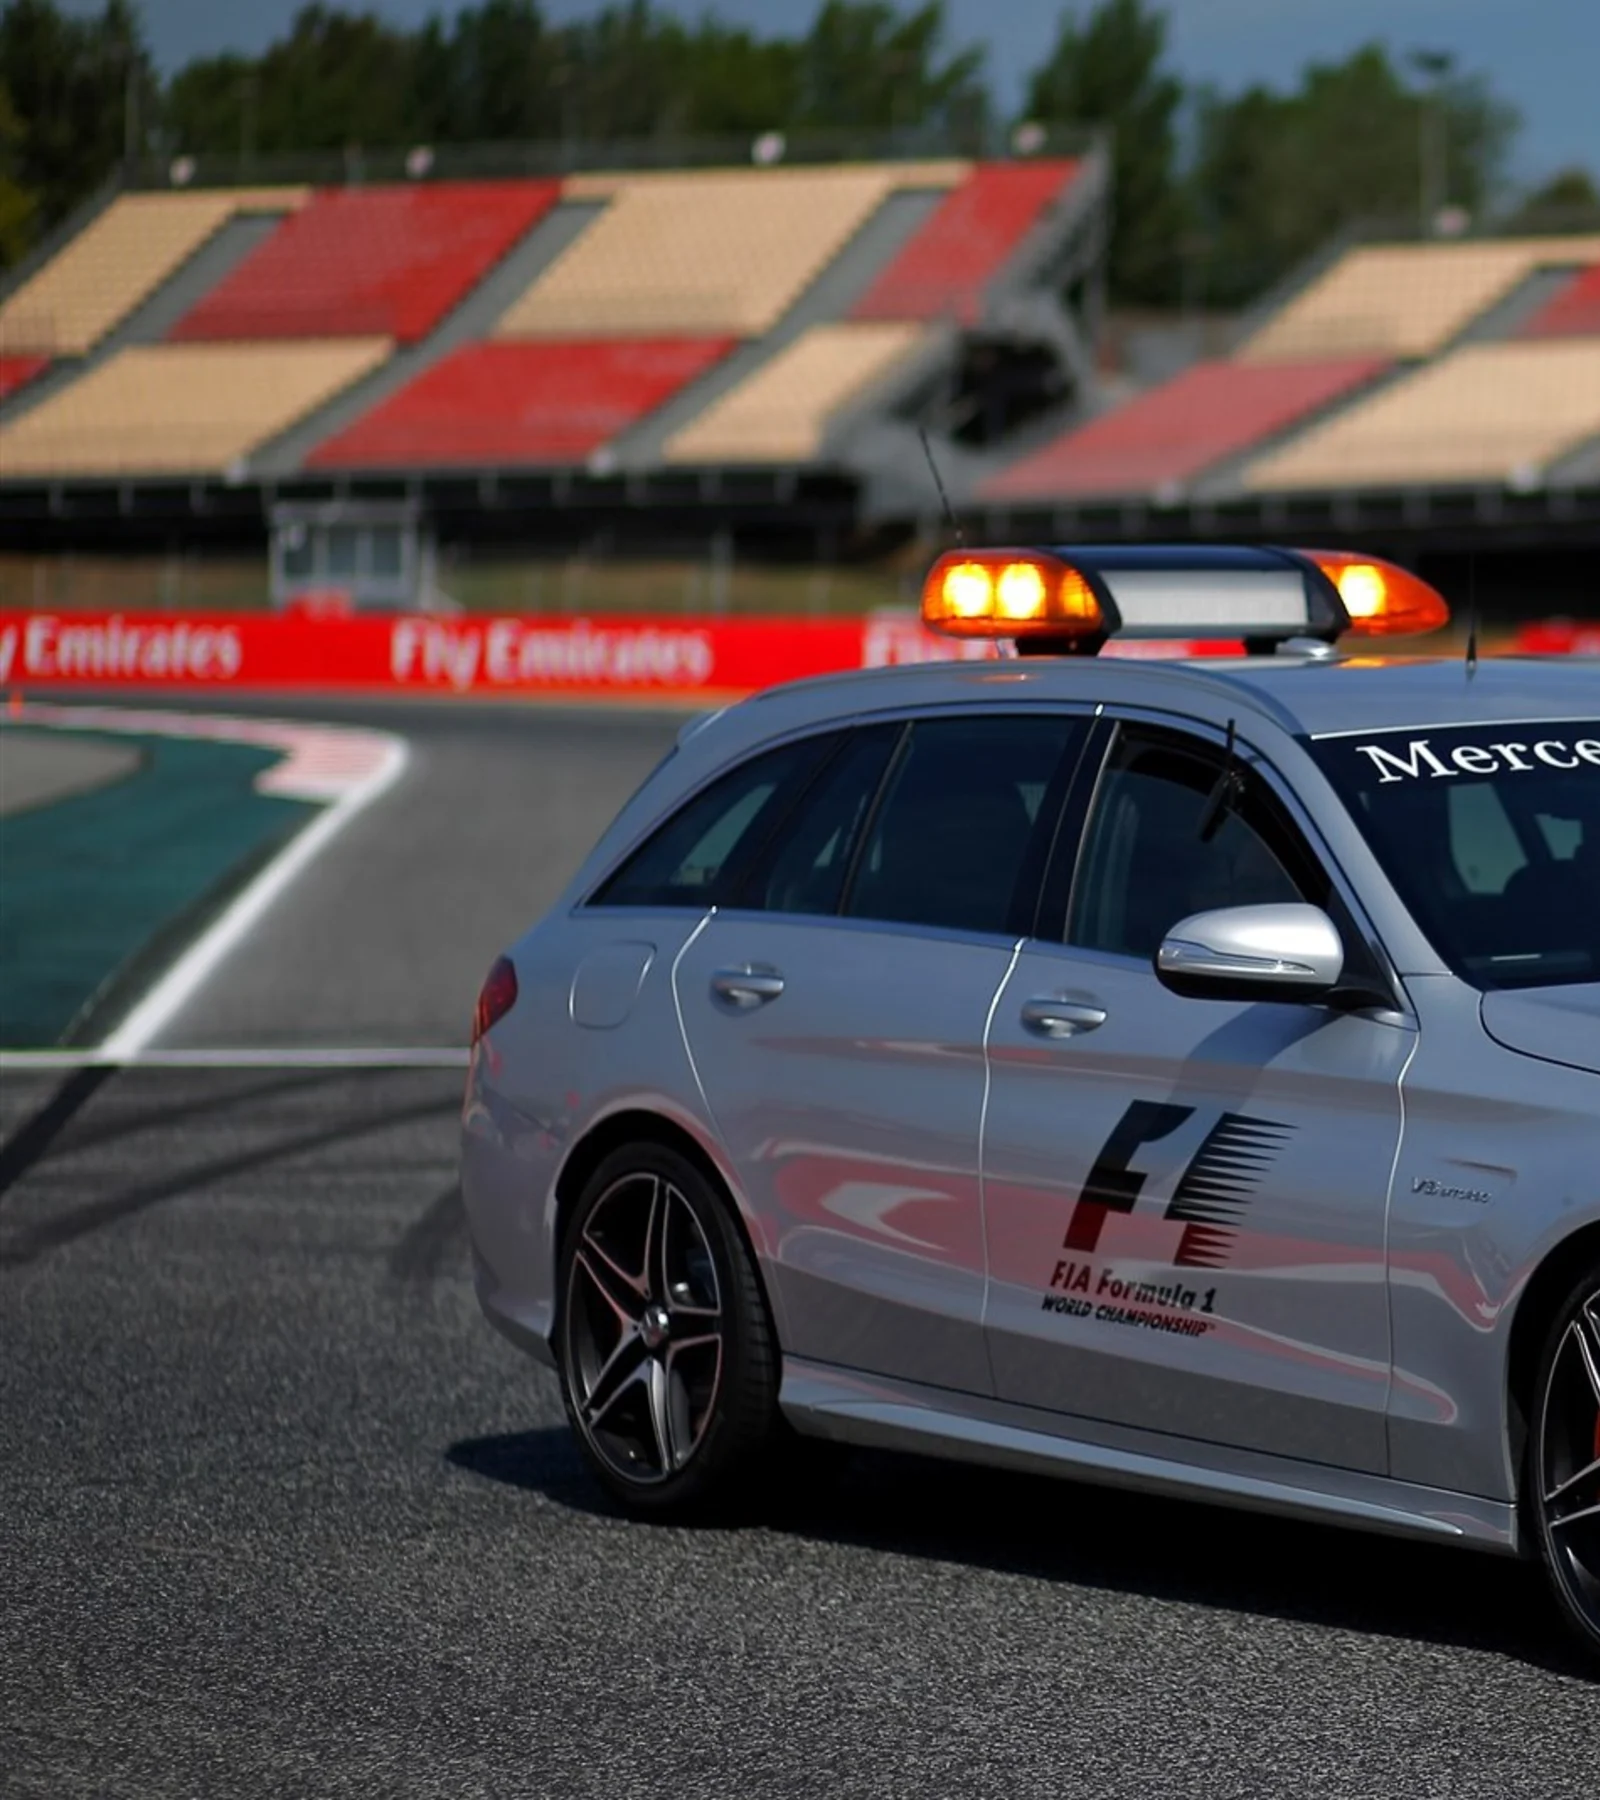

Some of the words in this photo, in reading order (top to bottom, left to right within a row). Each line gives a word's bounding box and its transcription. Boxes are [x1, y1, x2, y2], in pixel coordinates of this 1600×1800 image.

[390, 617, 482, 692] Fly
[486, 616, 714, 684] Emirates
[1042, 1294, 1093, 1318] WORLD
[1050, 1260, 1092, 1293] FIA
[1095, 1268, 1197, 1311] Formula
[1201, 1286, 1218, 1313] 1
